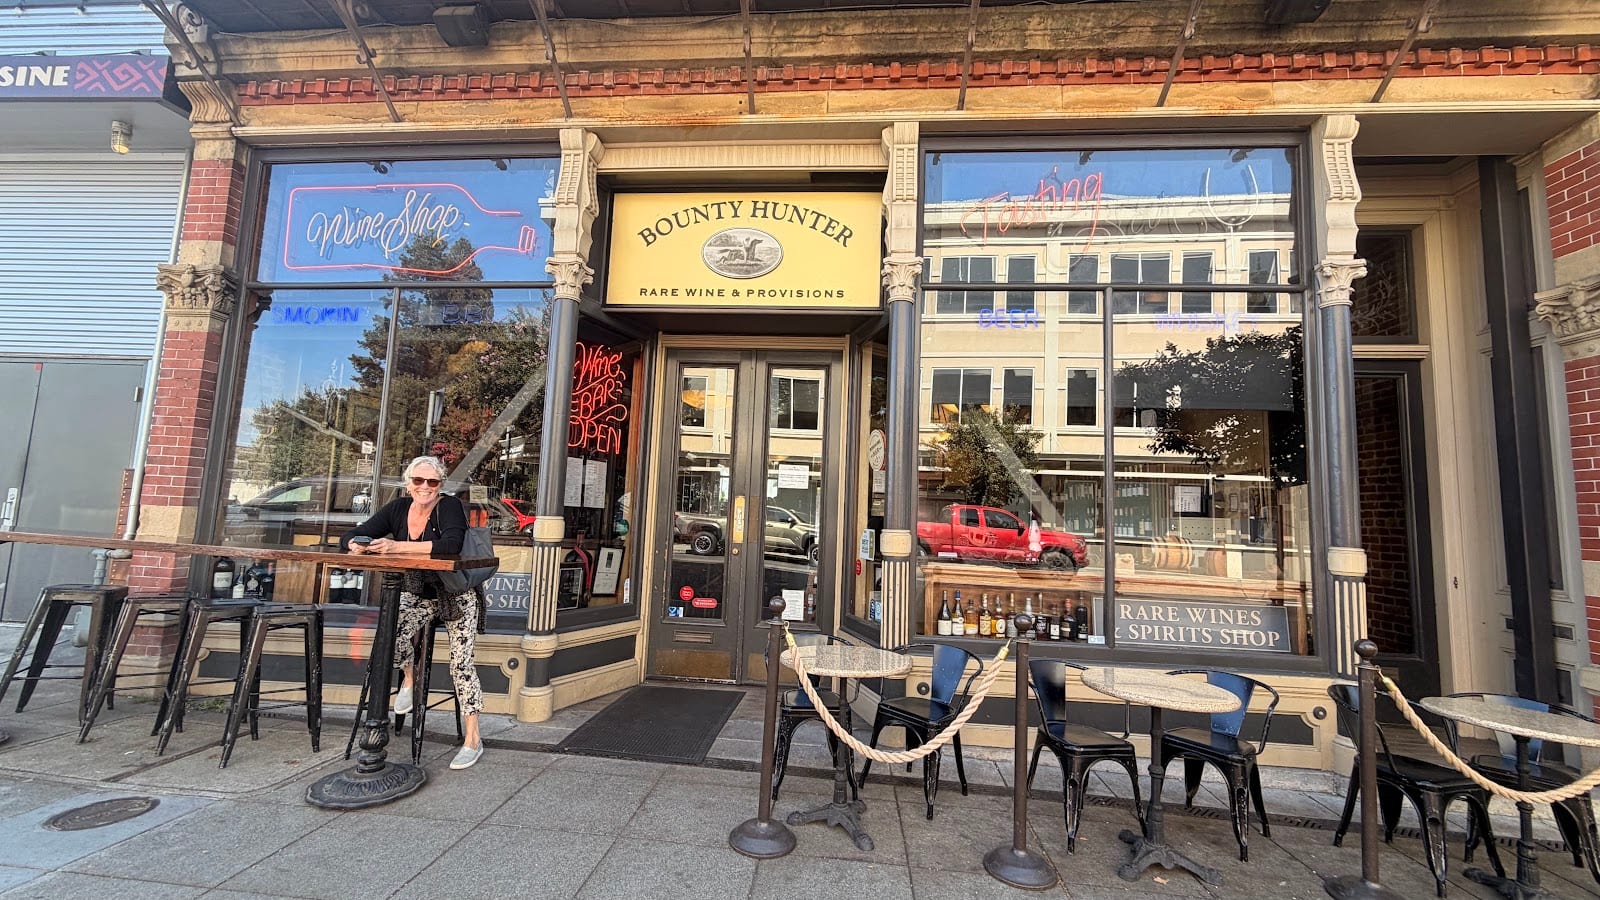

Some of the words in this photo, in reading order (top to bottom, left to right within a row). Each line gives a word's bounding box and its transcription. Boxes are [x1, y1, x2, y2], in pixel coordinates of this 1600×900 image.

[306, 206, 385, 257] Wine
[380, 189, 460, 260] Shop
[637, 200, 744, 247] BOUNTY
[750, 200, 855, 248] HUNTER
[960, 166, 1103, 256] Tasting
[639, 287, 680, 298] RARE
[685, 288, 726, 298] WINE
[731, 289, 741, 298] &
[746, 289, 846, 299] PROVISIONS
[978, 308, 1040, 329] BEER
[574, 342, 623, 391] Wine
[579, 378, 618, 420] BAR
[498, 594, 530, 608] SHO
[1119, 604, 1180, 622] RARE
[1185, 607, 1262, 626] WINES
[1128, 624, 1213, 644] SPIRITS
[1219, 628, 1280, 647] SHOP
